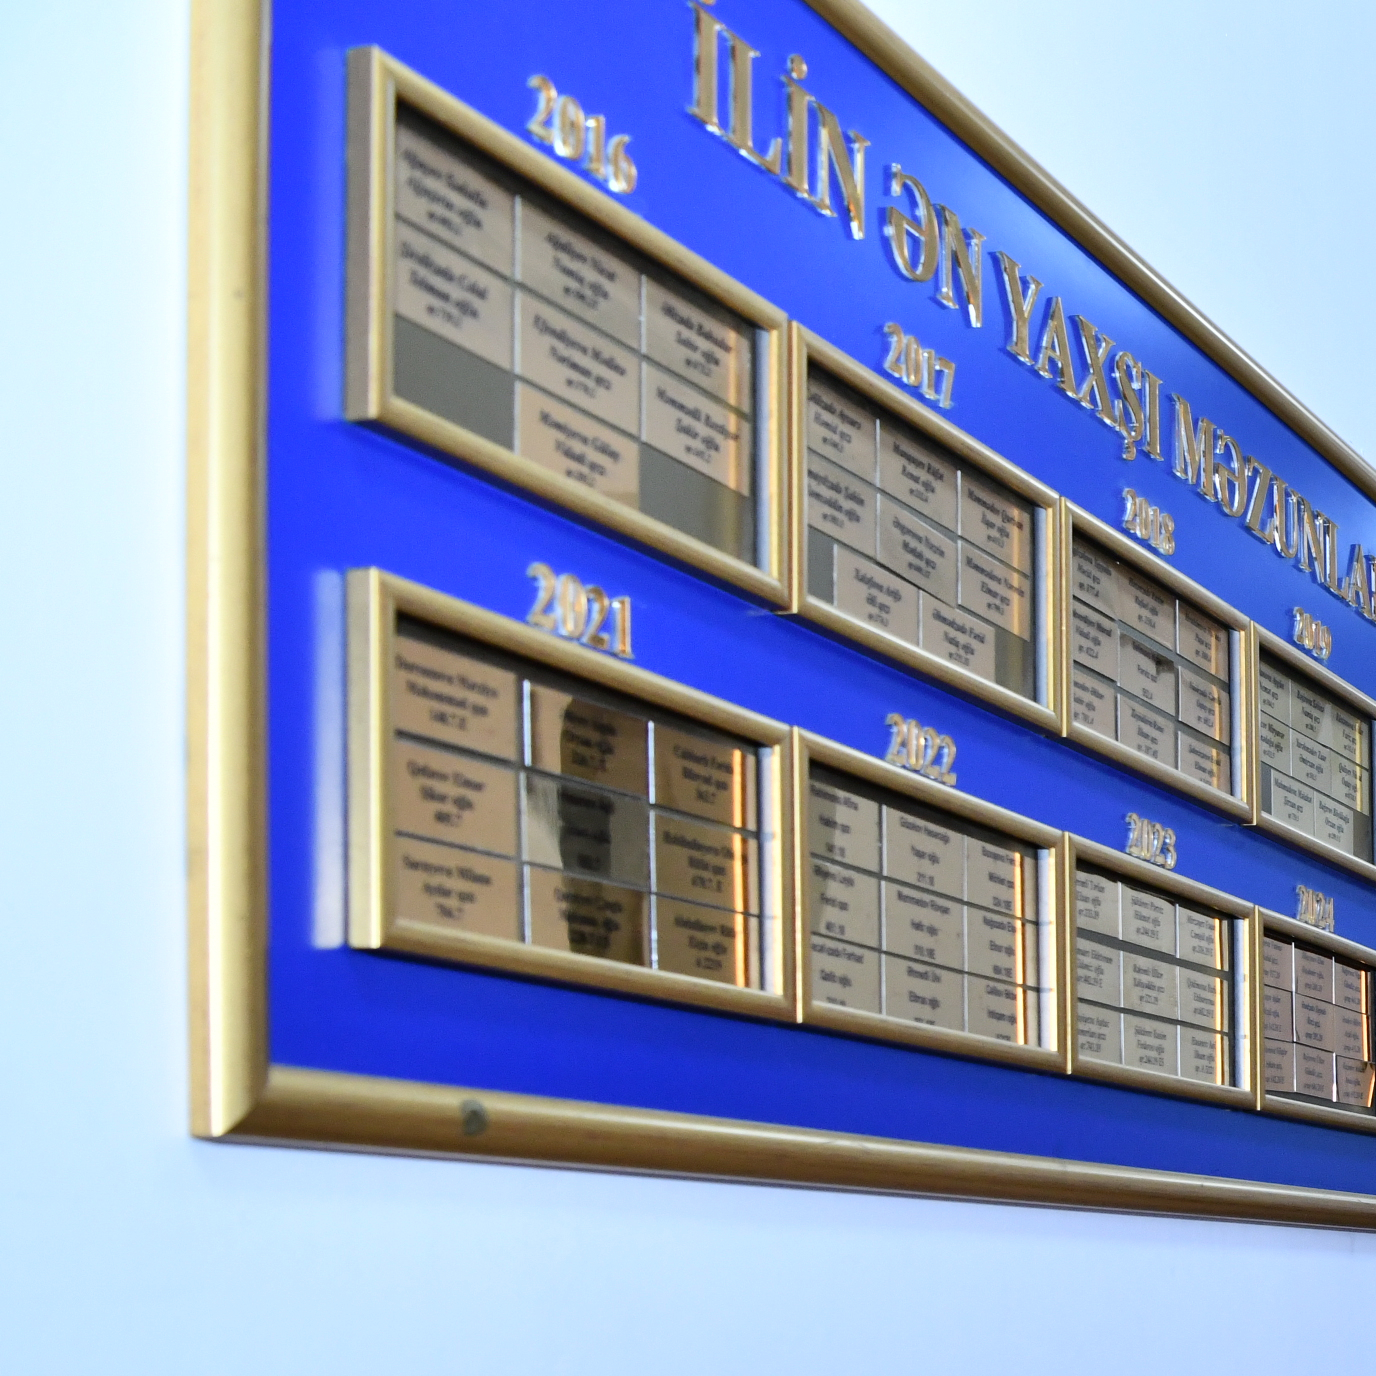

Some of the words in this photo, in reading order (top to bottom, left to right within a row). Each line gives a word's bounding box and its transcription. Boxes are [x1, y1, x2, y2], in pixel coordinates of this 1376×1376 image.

[526, 74, 638, 194] 2016
[686, 0, 870, 240] İLİN
[884, 163, 986, 327] ƏN
[996, 250, 1164, 461] YAXŞI
[884, 323, 955, 409] 2017
[1122, 488, 1175, 555] 2018
[526, 562, 635, 659] 2021
[1292, 607, 1332, 659] 2019
[884, 713, 957, 787] 2022
[1125, 812, 1177, 870] 2023
[1297, 885, 1335, 932] 2024
